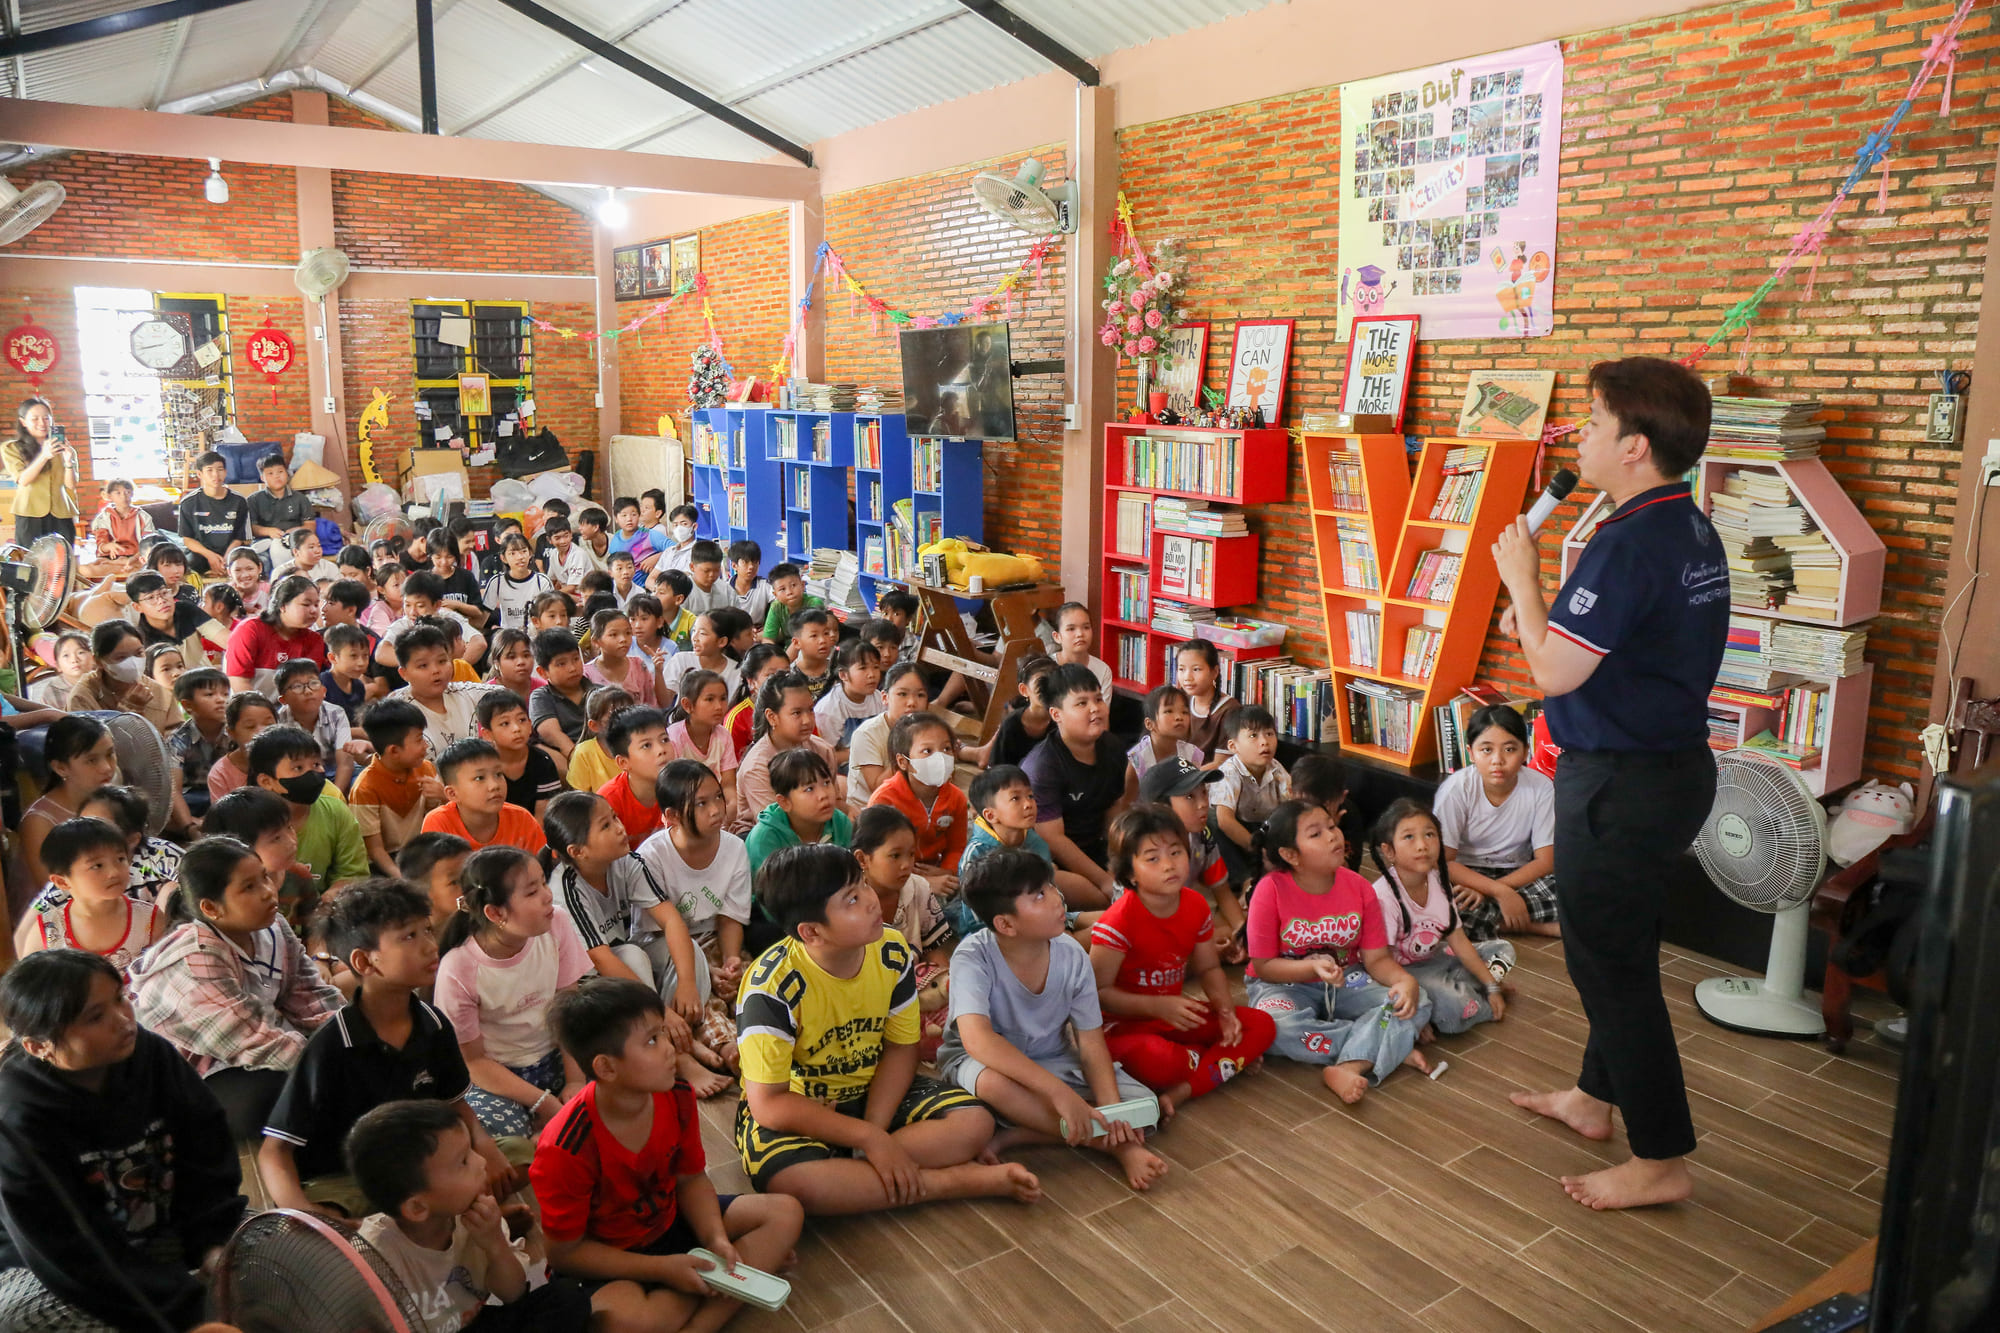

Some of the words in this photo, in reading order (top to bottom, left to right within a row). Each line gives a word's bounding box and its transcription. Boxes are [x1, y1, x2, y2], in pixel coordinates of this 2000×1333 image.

[1244, 326, 1280, 349] YOU
[1368, 328, 1400, 351] THE
[1241, 348, 1271, 367] CAN
[1365, 350, 1397, 368] MORE
[1361, 375, 1392, 398] THE
[1357, 398, 1389, 414] MORE
[1293, 915, 1360, 936] EXCITING
